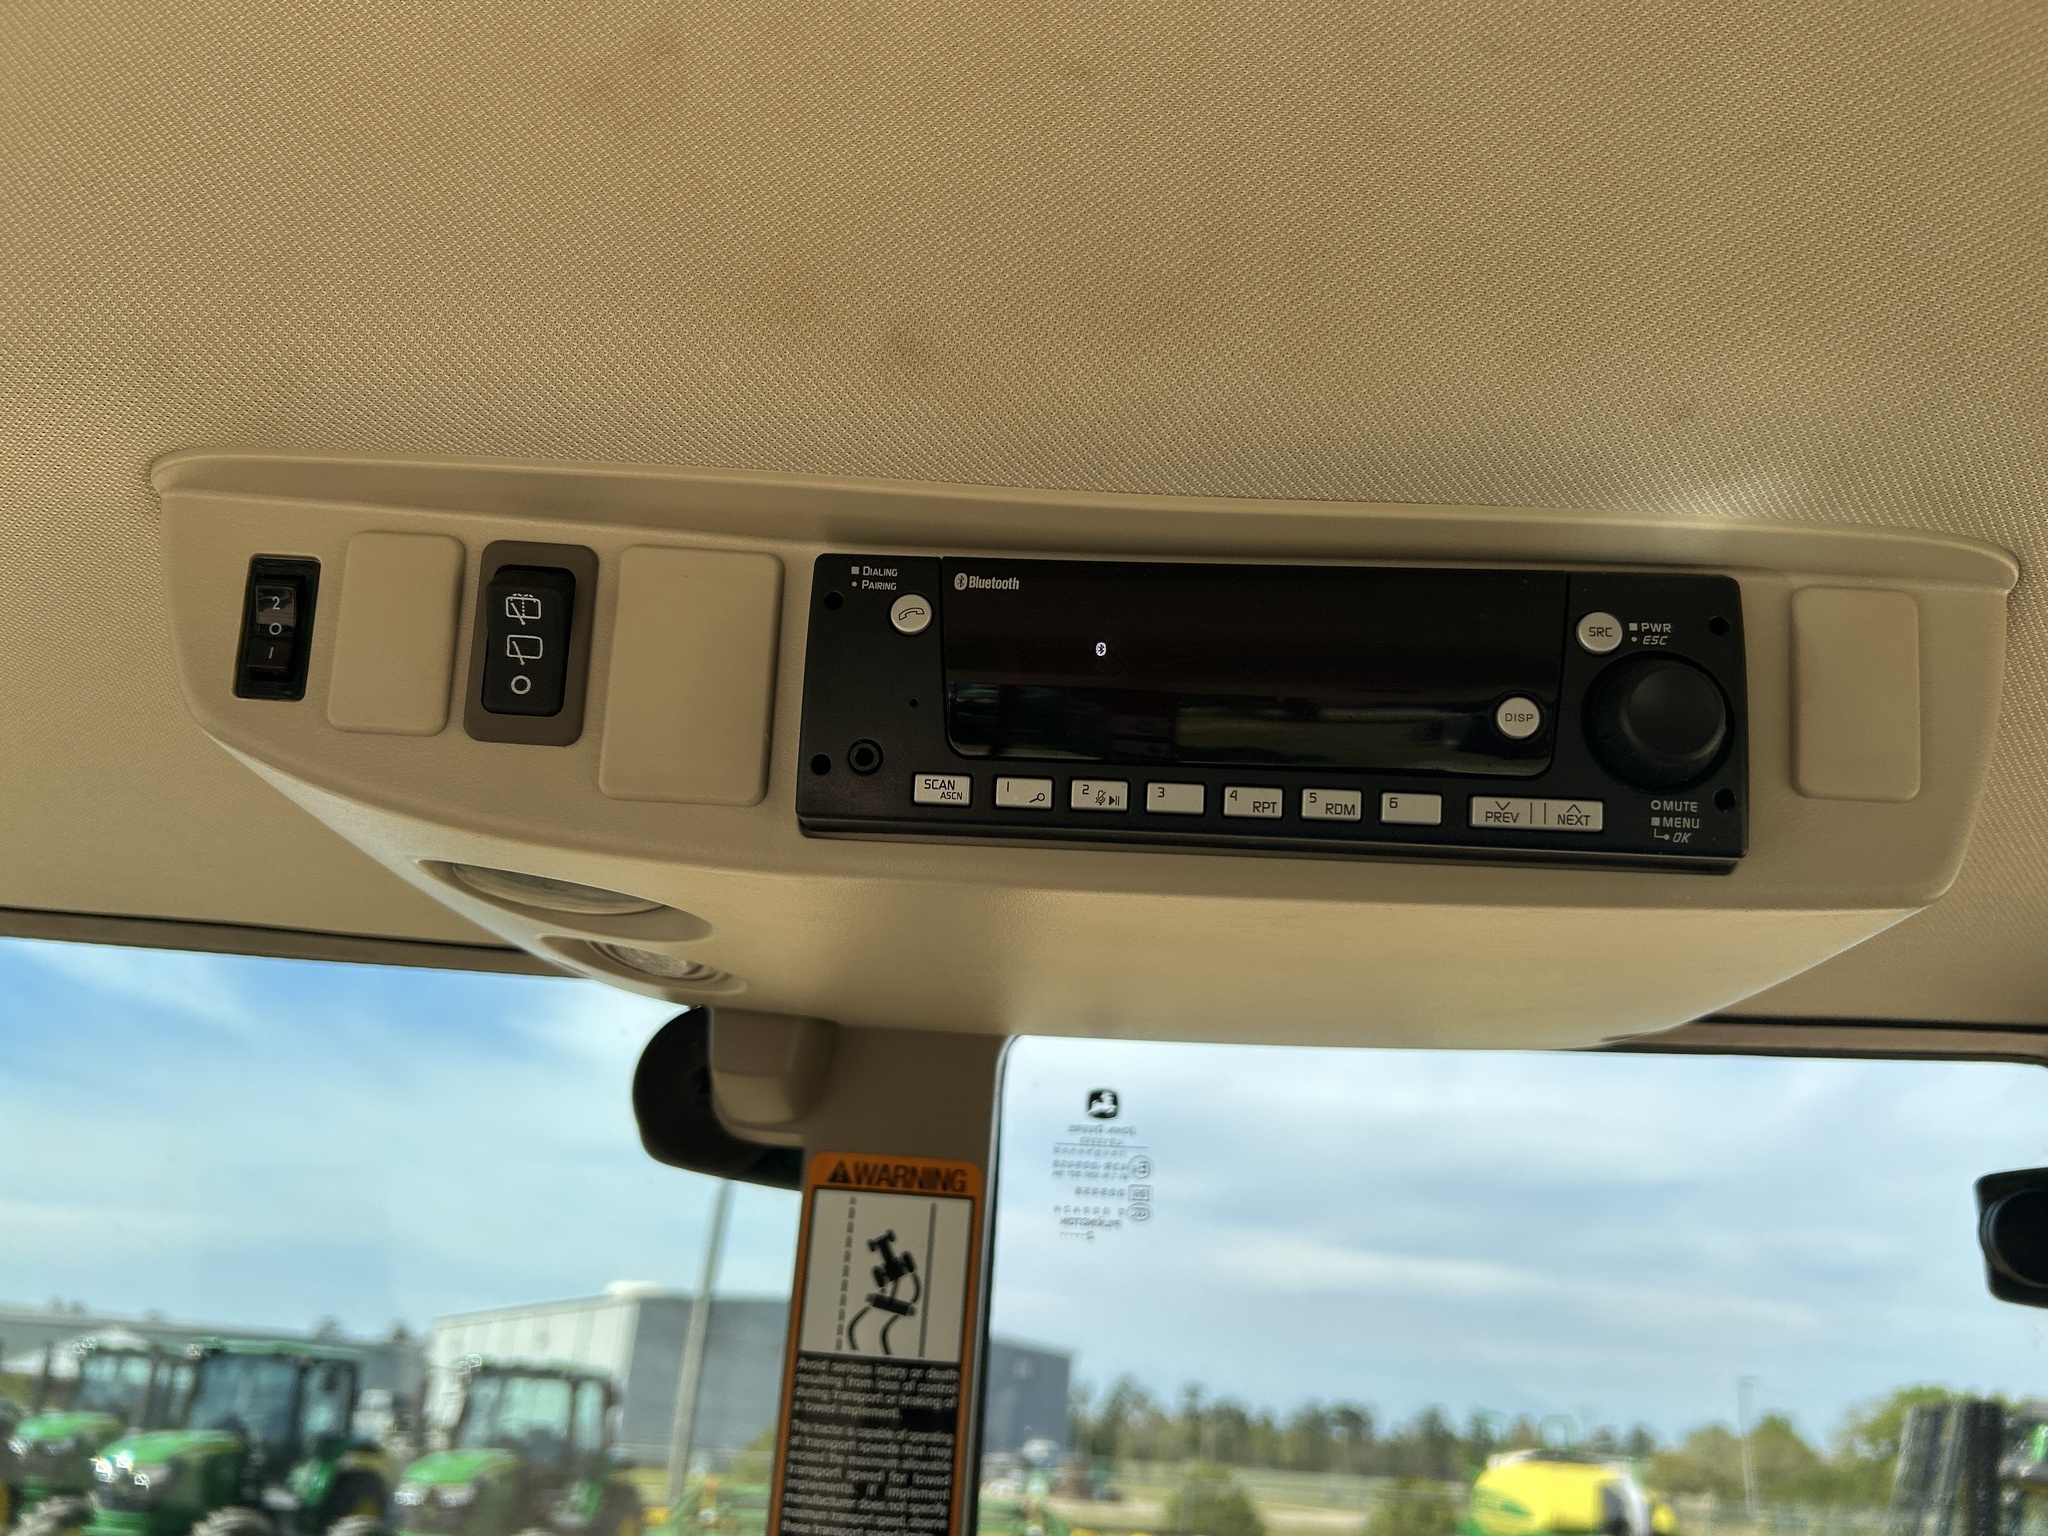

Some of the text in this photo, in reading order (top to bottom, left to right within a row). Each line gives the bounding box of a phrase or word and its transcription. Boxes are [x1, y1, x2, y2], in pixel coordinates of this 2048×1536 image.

[862, 566, 898, 577] DIALING
[861, 579, 897, 591] PAIRING
[968, 576, 1020, 590] Bluetooth
[272, 596, 281, 610] 2
[1588, 626, 1613, 638] SRC
[1641, 622, 1672, 634] PWR
[1642, 635, 1669, 646] ESC
[1504, 713, 1534, 723] DISP
[924, 778, 956, 791] SCAN
[1082, 784, 1090, 795] 2
[940, 791, 963, 801] ASCN
[1157, 787, 1165, 798] 3
[1229, 790, 1238, 801] 4
[1309, 792, 1318, 804] 5
[1252, 801, 1278, 814] RPT
[1389, 797, 1398, 809] 6
[1662, 800, 1698, 813] MUTE
[1324, 803, 1356, 816] RDM
[1485, 811, 1520, 824] PREV
[1557, 814, 1591, 827] NEXT
[1662, 816, 1700, 830] MENU
[1672, 831, 1692, 844] OK
[854, 1161, 968, 1193] WARNING
